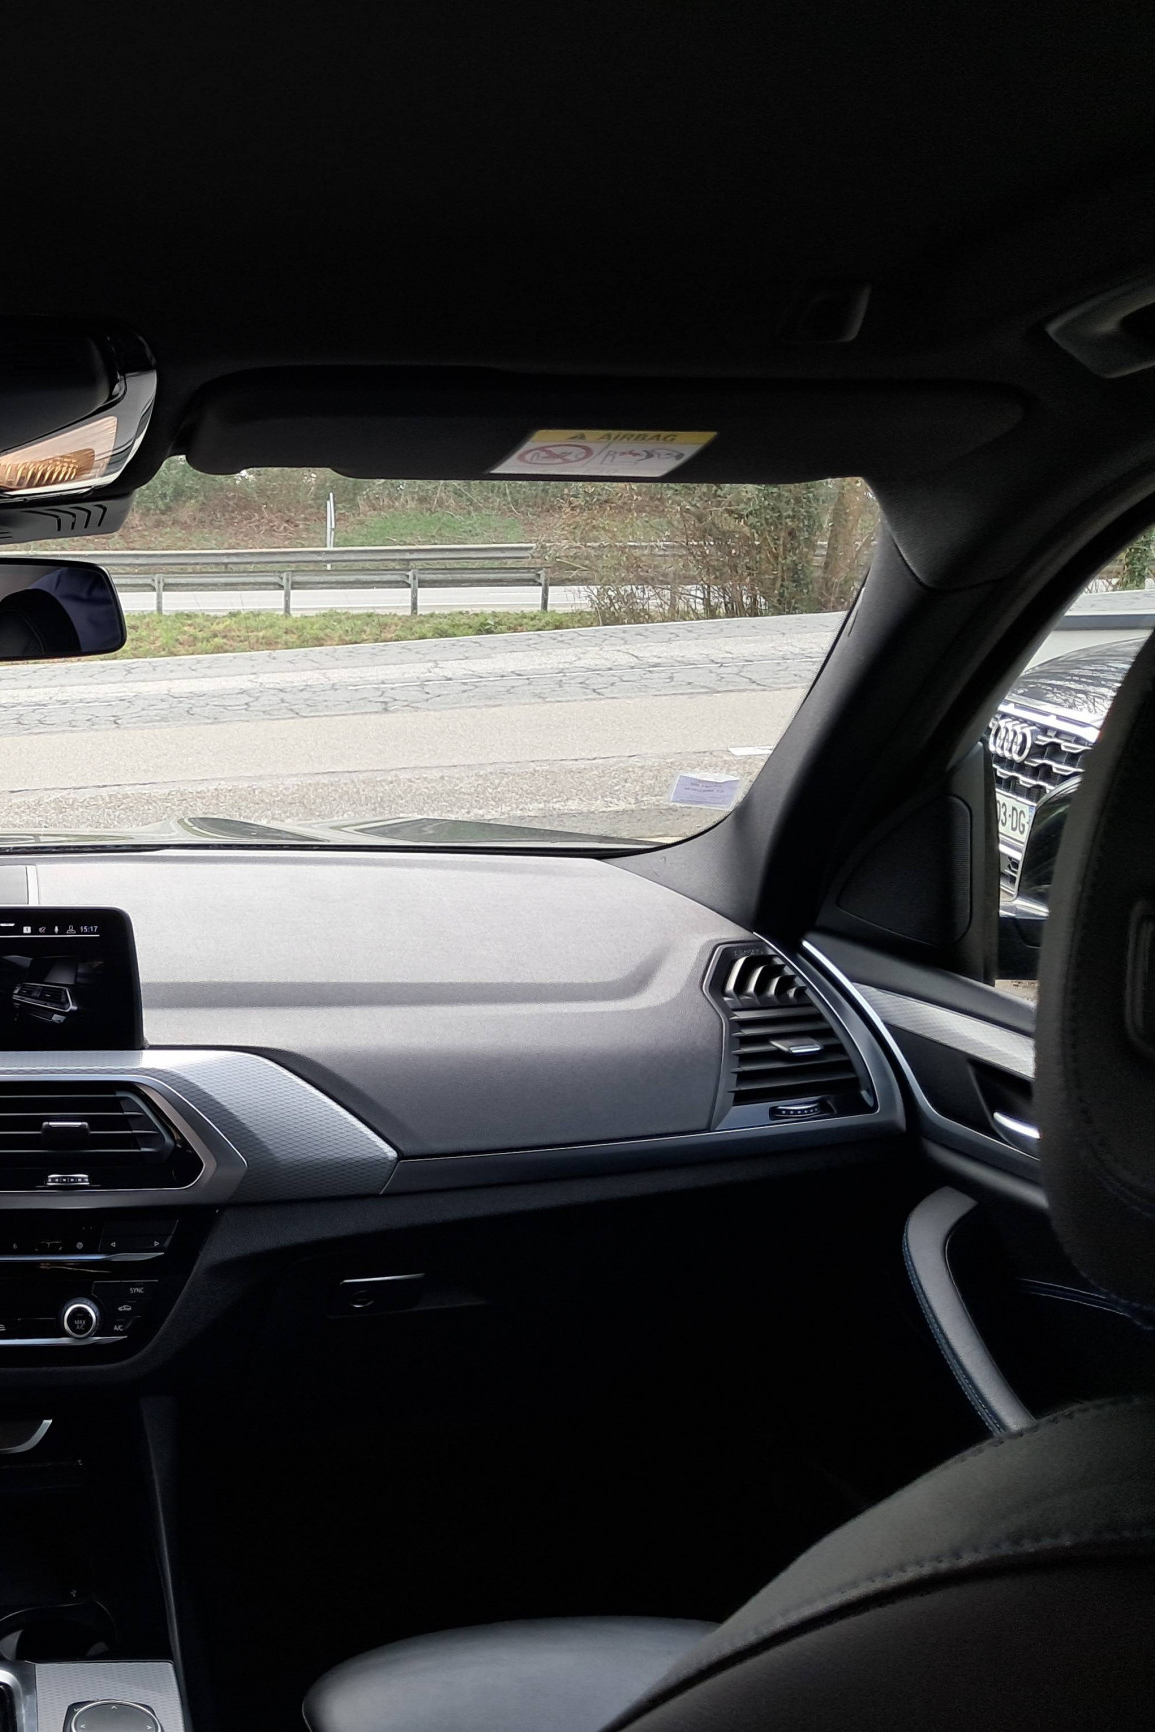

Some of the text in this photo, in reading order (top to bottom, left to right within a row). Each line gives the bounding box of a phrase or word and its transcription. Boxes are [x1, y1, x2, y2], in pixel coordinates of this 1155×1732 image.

[598, 433, 678, 442] AIRBAG
[79, 925, 99, 933] 15:17
[129, 1286, 145, 1294] SYNC
